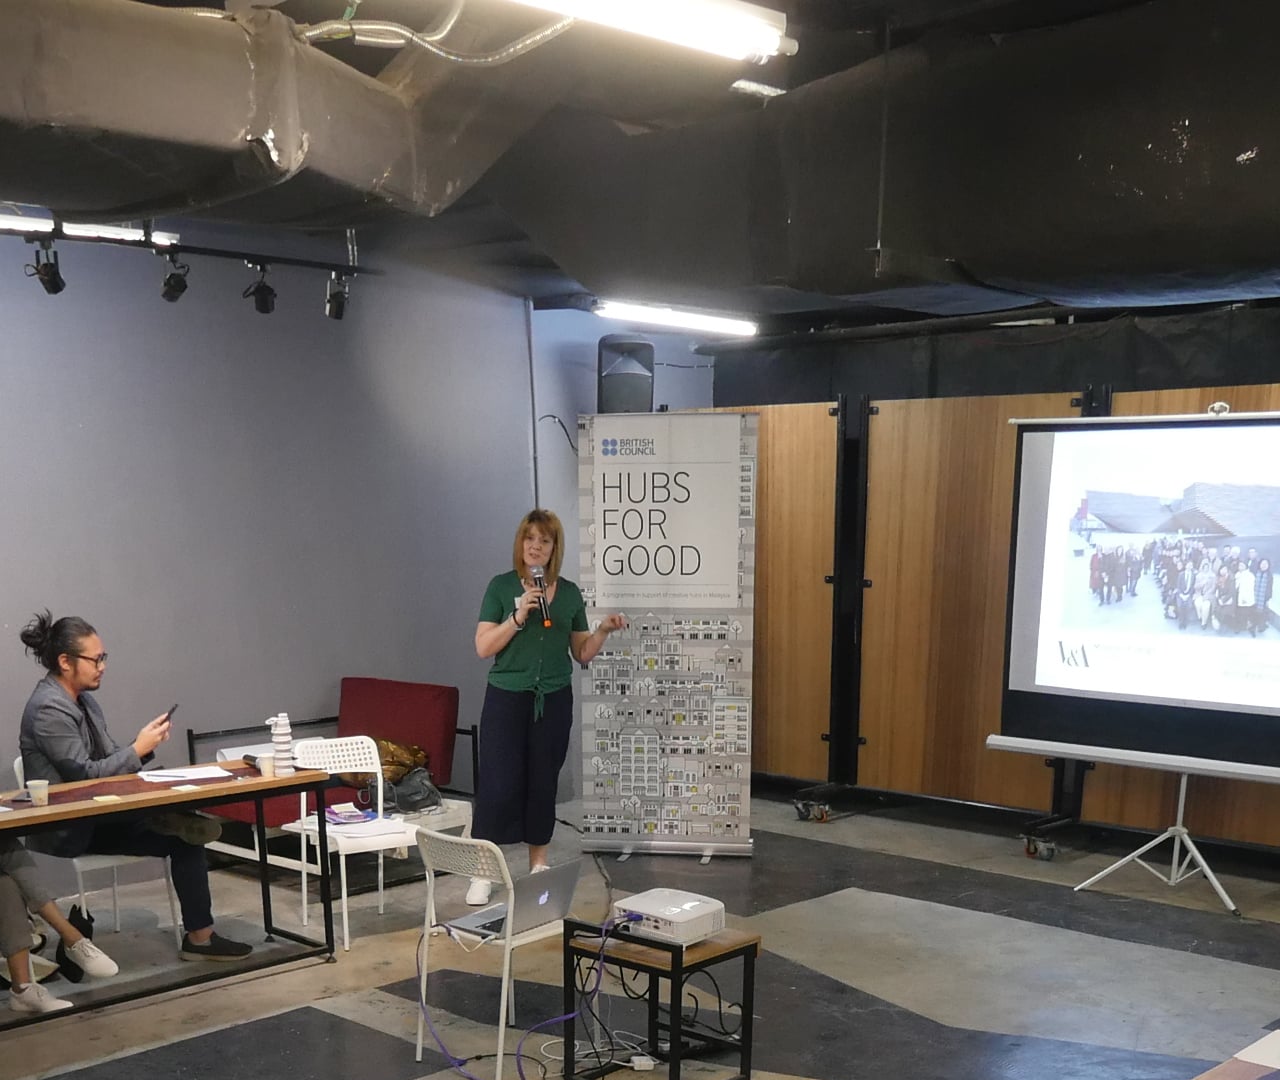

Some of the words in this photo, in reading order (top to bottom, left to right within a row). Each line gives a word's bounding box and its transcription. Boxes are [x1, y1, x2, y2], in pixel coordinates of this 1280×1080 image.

[619, 439, 654, 448] BRITISH
[619, 447, 656, 456] COUNCIL
[602, 471, 691, 504] HUBS
[602, 508, 667, 541] FOR
[602, 544, 701, 576] GOOD
